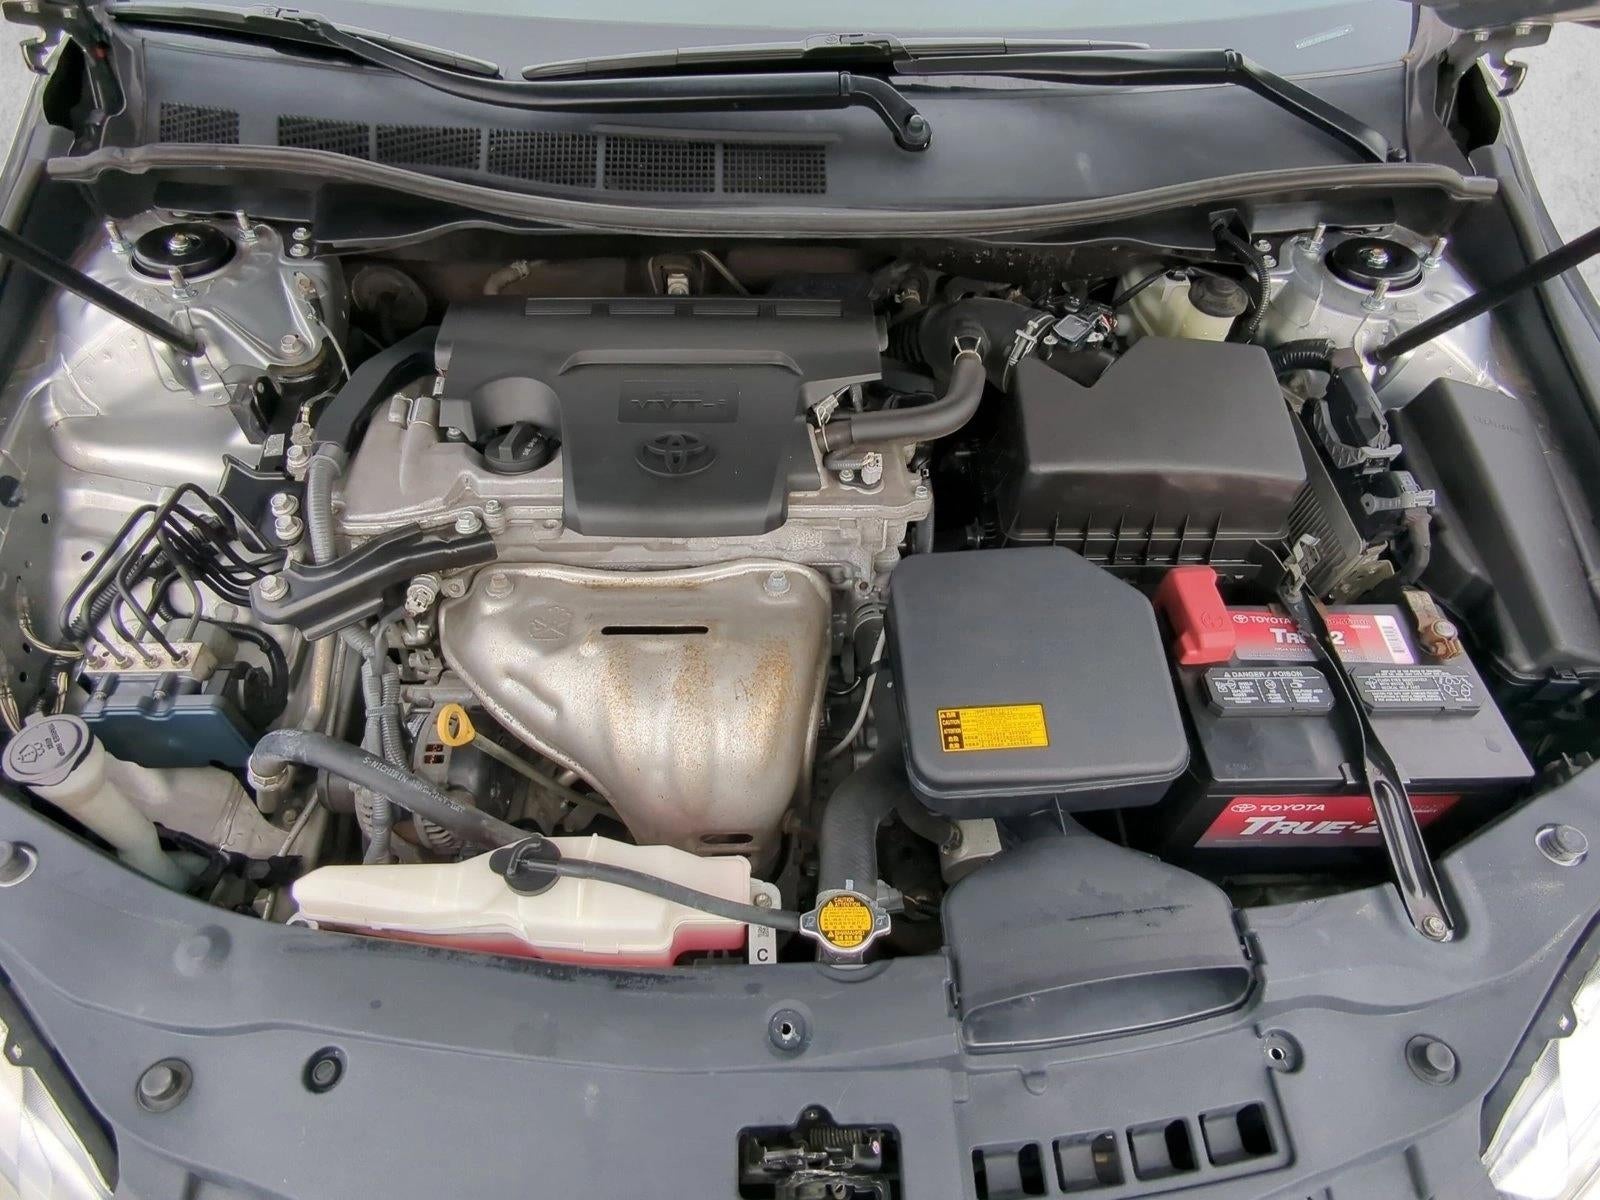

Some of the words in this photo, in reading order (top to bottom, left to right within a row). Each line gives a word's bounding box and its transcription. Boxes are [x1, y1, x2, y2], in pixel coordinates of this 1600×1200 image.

[1250, 615, 1292, 624] TOYOTA
[1260, 804, 1325, 812] TOYOTA
[757, 948, 769, 962] C
